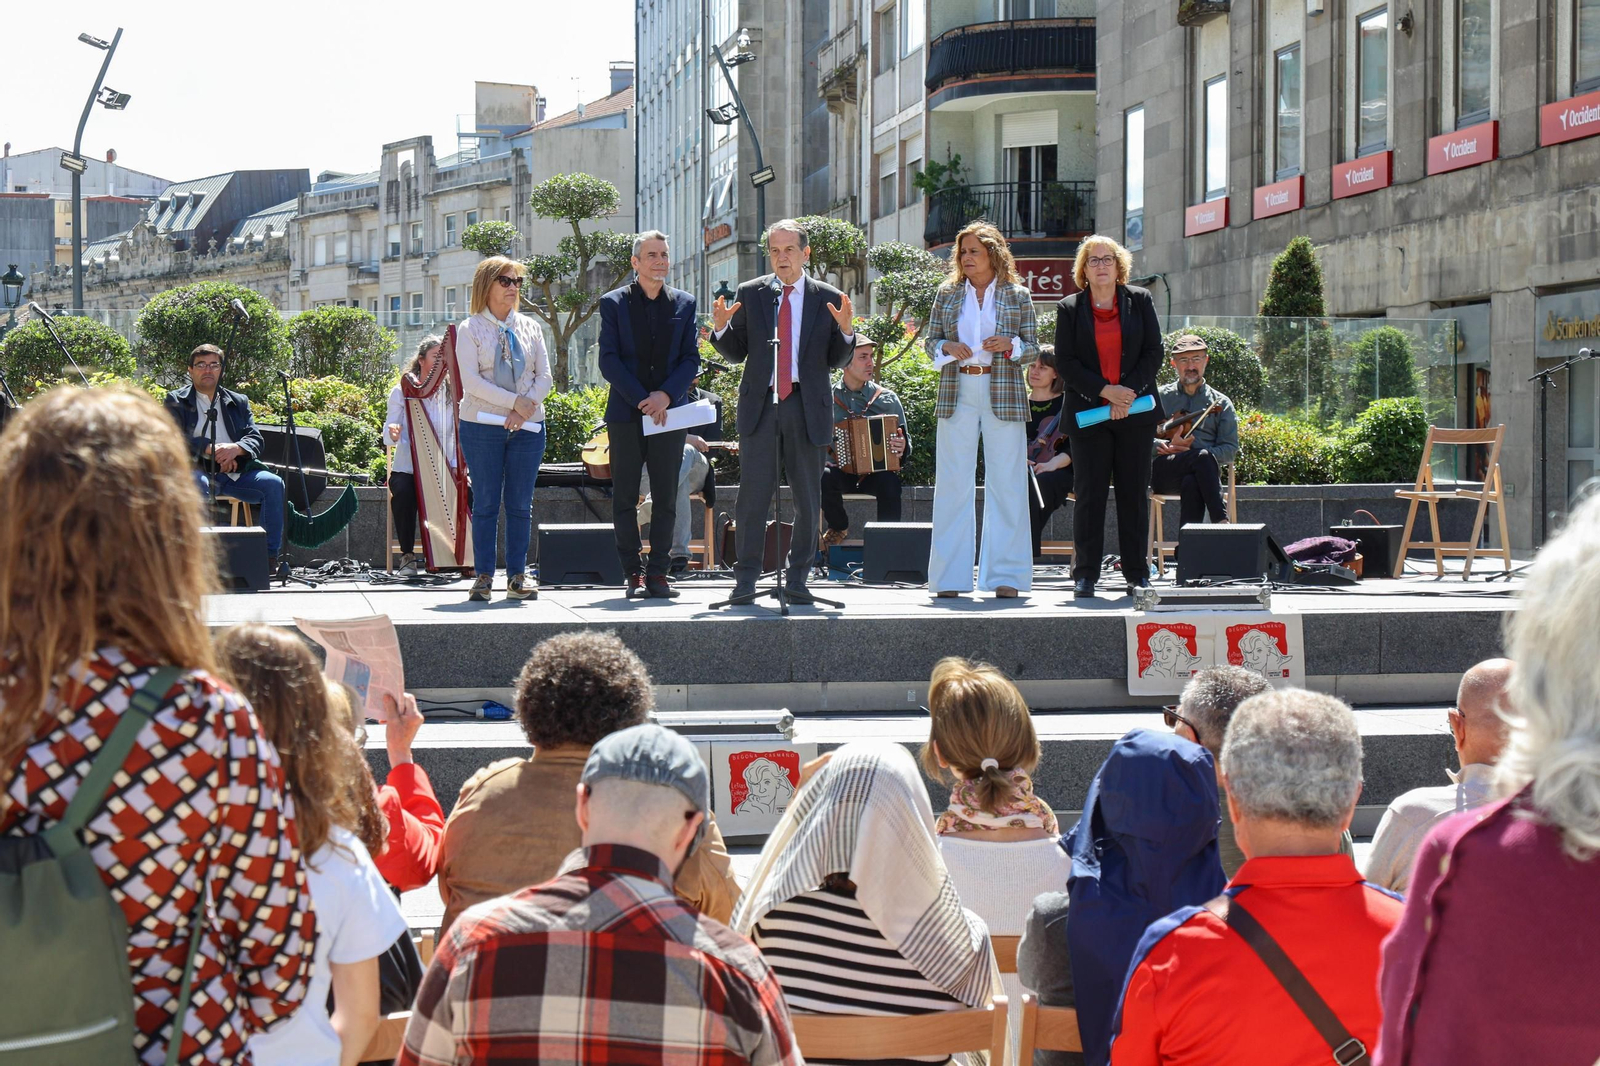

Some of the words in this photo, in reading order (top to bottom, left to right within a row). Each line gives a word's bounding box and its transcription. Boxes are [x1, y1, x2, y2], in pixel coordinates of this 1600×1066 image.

[1569, 104, 1600, 127] Occident
[1451, 138, 1477, 158] Occident
[1352, 167, 1374, 185] Occident
